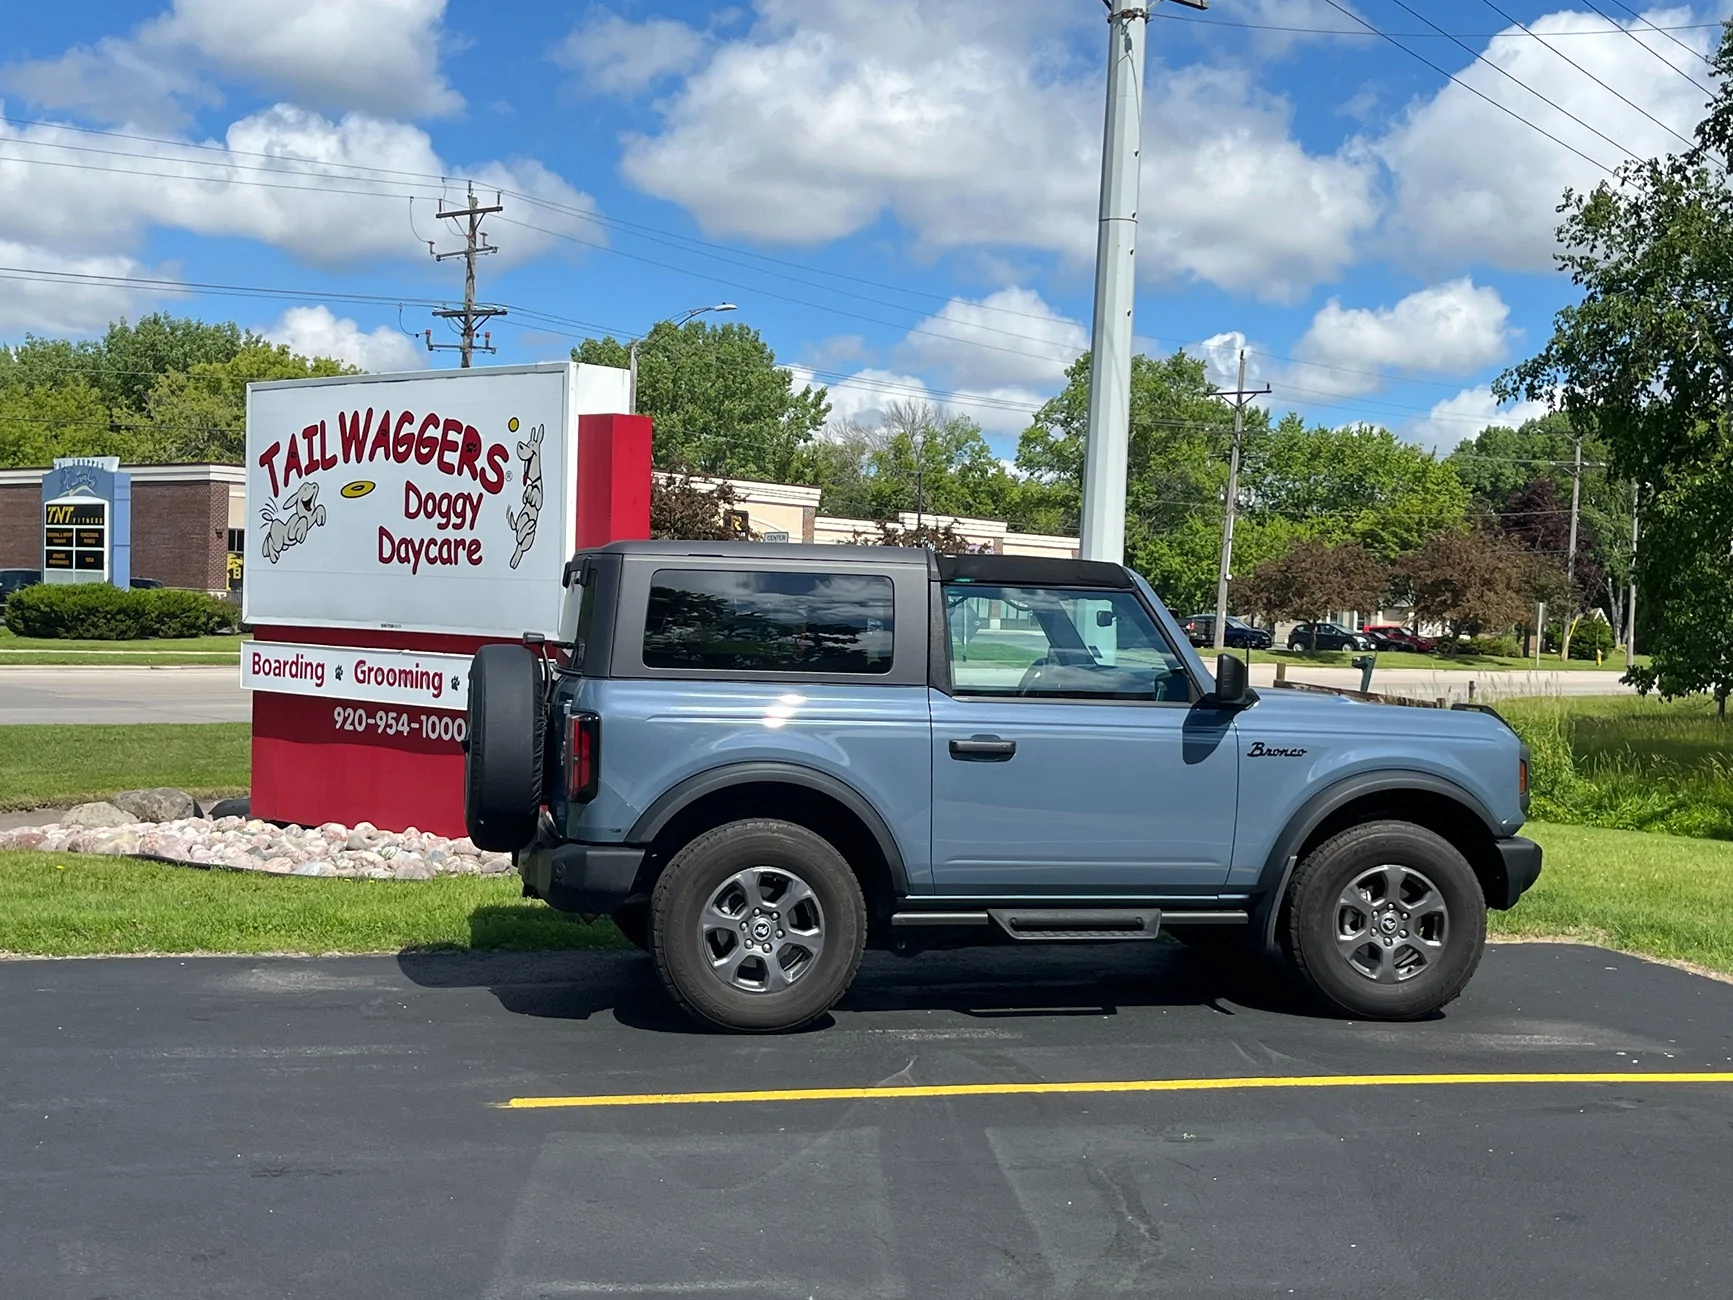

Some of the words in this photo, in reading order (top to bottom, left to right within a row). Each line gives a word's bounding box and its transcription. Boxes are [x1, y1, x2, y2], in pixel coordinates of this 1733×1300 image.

[47, 506, 74, 523] TNT
[405, 480, 484, 531] Doggy
[378, 525, 483, 575] Daycare
[252, 652, 325, 687] Boarding
[354, 659, 443, 698] Grooming
[333, 706, 467, 742] 920-954-1000
[1247, 742, 1307, 757] Bronco
